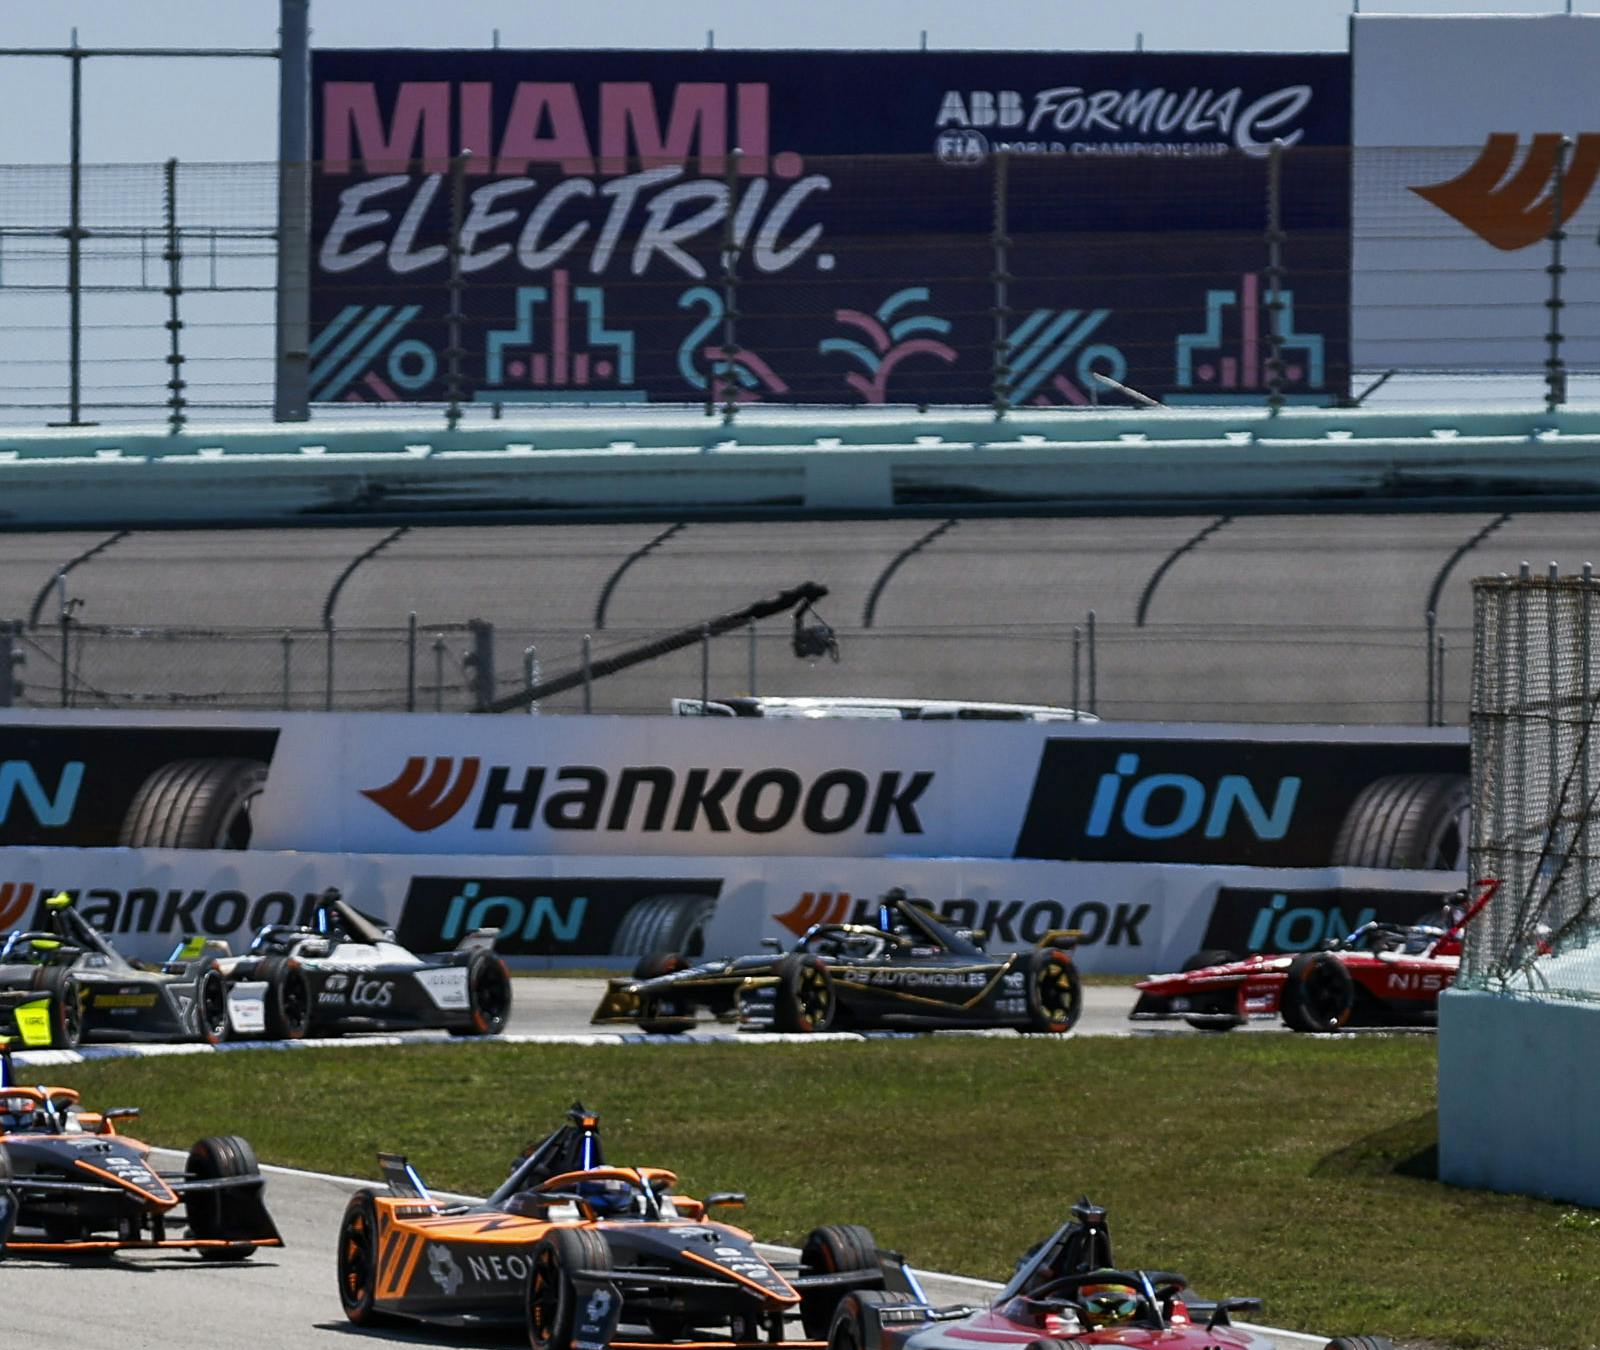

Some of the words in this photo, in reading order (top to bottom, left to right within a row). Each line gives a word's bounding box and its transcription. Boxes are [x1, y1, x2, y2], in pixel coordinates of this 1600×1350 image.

[936, 90, 1024, 127] ABB
[1027, 86, 1242, 133] FORMULA
[322, 81, 802, 176] MIAMI.
[993, 142, 1066, 157] WORLD
[1071, 142, 1230, 158] CHAMPIONSHIP
[320, 164, 835, 278] ELECTRIC.
[874, 972, 987, 986] AUTOMOBILES
[467, 1255, 533, 1281] NEO
